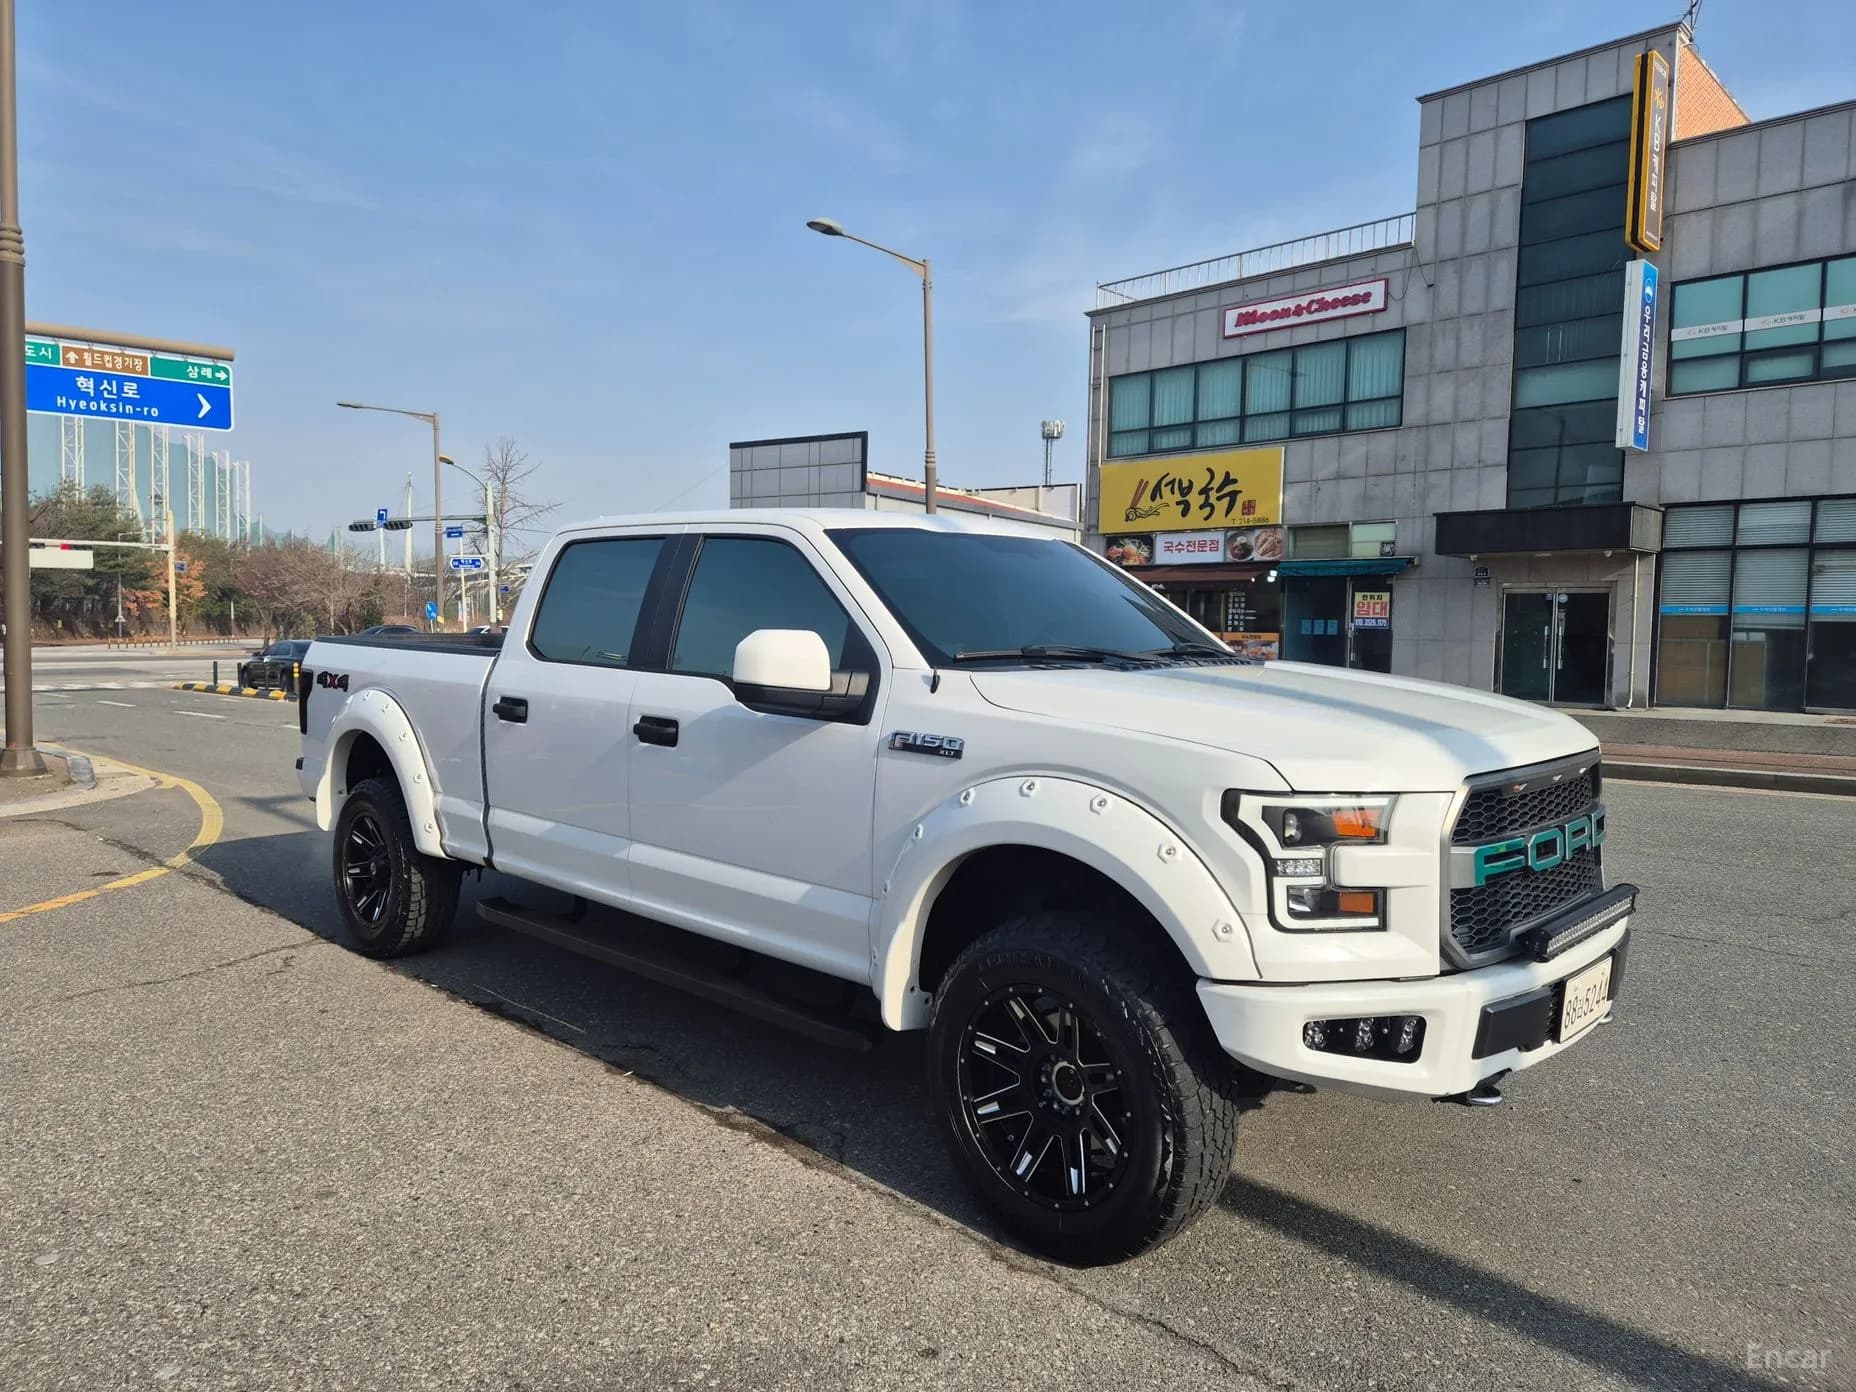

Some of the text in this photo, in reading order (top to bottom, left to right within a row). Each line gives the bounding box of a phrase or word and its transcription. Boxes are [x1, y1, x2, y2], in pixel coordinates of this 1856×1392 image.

[83, 351, 143, 372] 월드컵경기장
[186, 365, 212, 379] 삼례
[1637, 301, 1652, 435] 우리금융캐피탈
[75, 376, 140, 399] 혁신로
[56, 395, 159, 417] Hyeoksin-ro
[1163, 539, 1220, 553] 국수전문점
[1356, 600, 1388, 617] 임대
[1474, 805, 1607, 887] FORD
